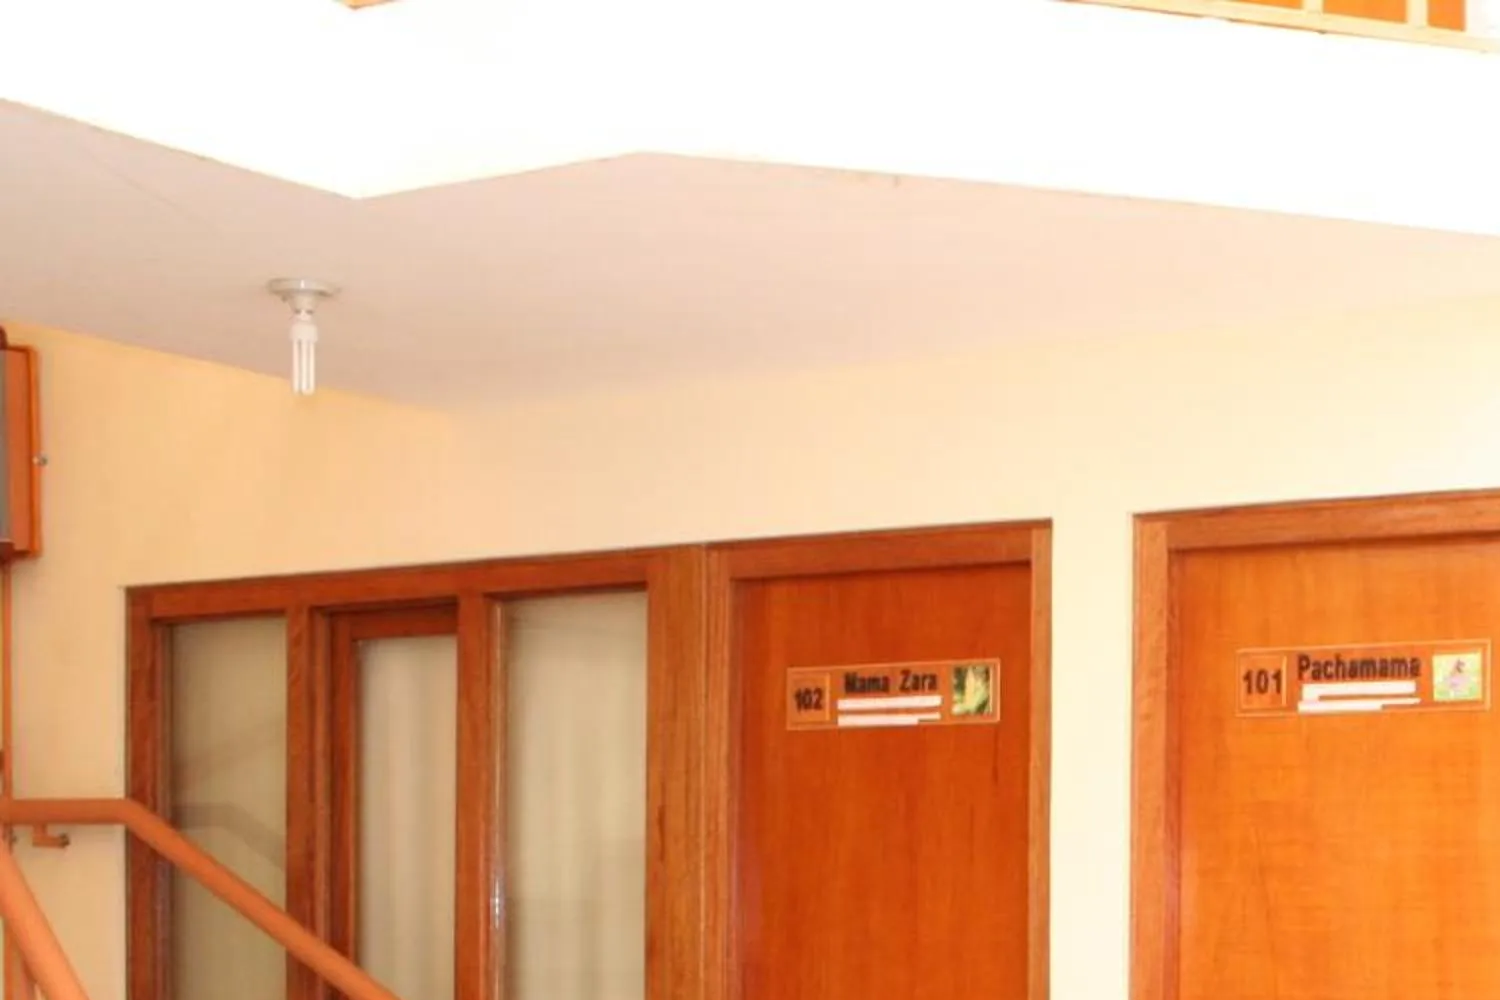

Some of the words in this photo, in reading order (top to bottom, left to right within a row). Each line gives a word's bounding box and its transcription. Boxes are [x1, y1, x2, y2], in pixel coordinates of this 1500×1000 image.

[1297, 654, 1421, 680] Pachamama
[844, 671, 890, 694] Mama
[899, 669, 937, 692] Zara
[1243, 669, 1282, 695] 101
[794, 687, 823, 711] 102
